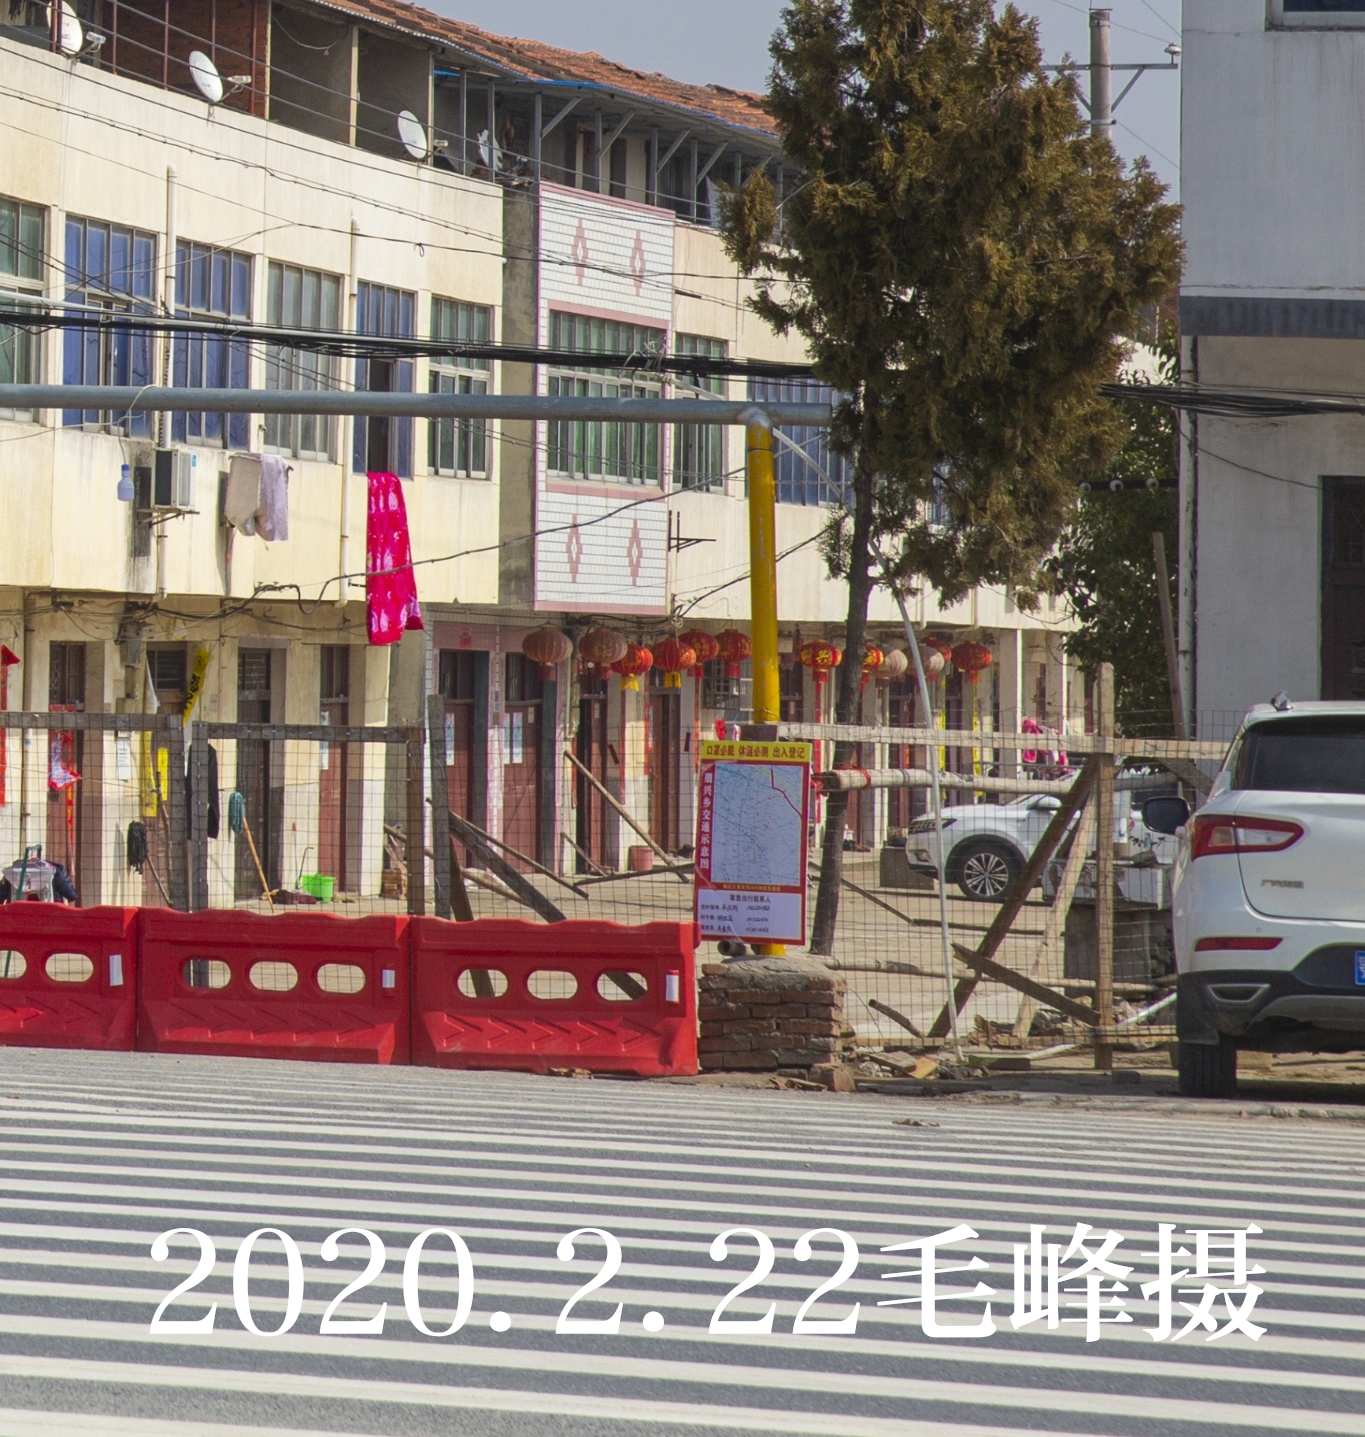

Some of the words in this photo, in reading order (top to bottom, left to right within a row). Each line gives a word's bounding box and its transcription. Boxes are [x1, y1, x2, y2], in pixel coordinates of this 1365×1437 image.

[738, 745, 769, 758] 体温必测
[772, 746, 805, 759] 出入登记
